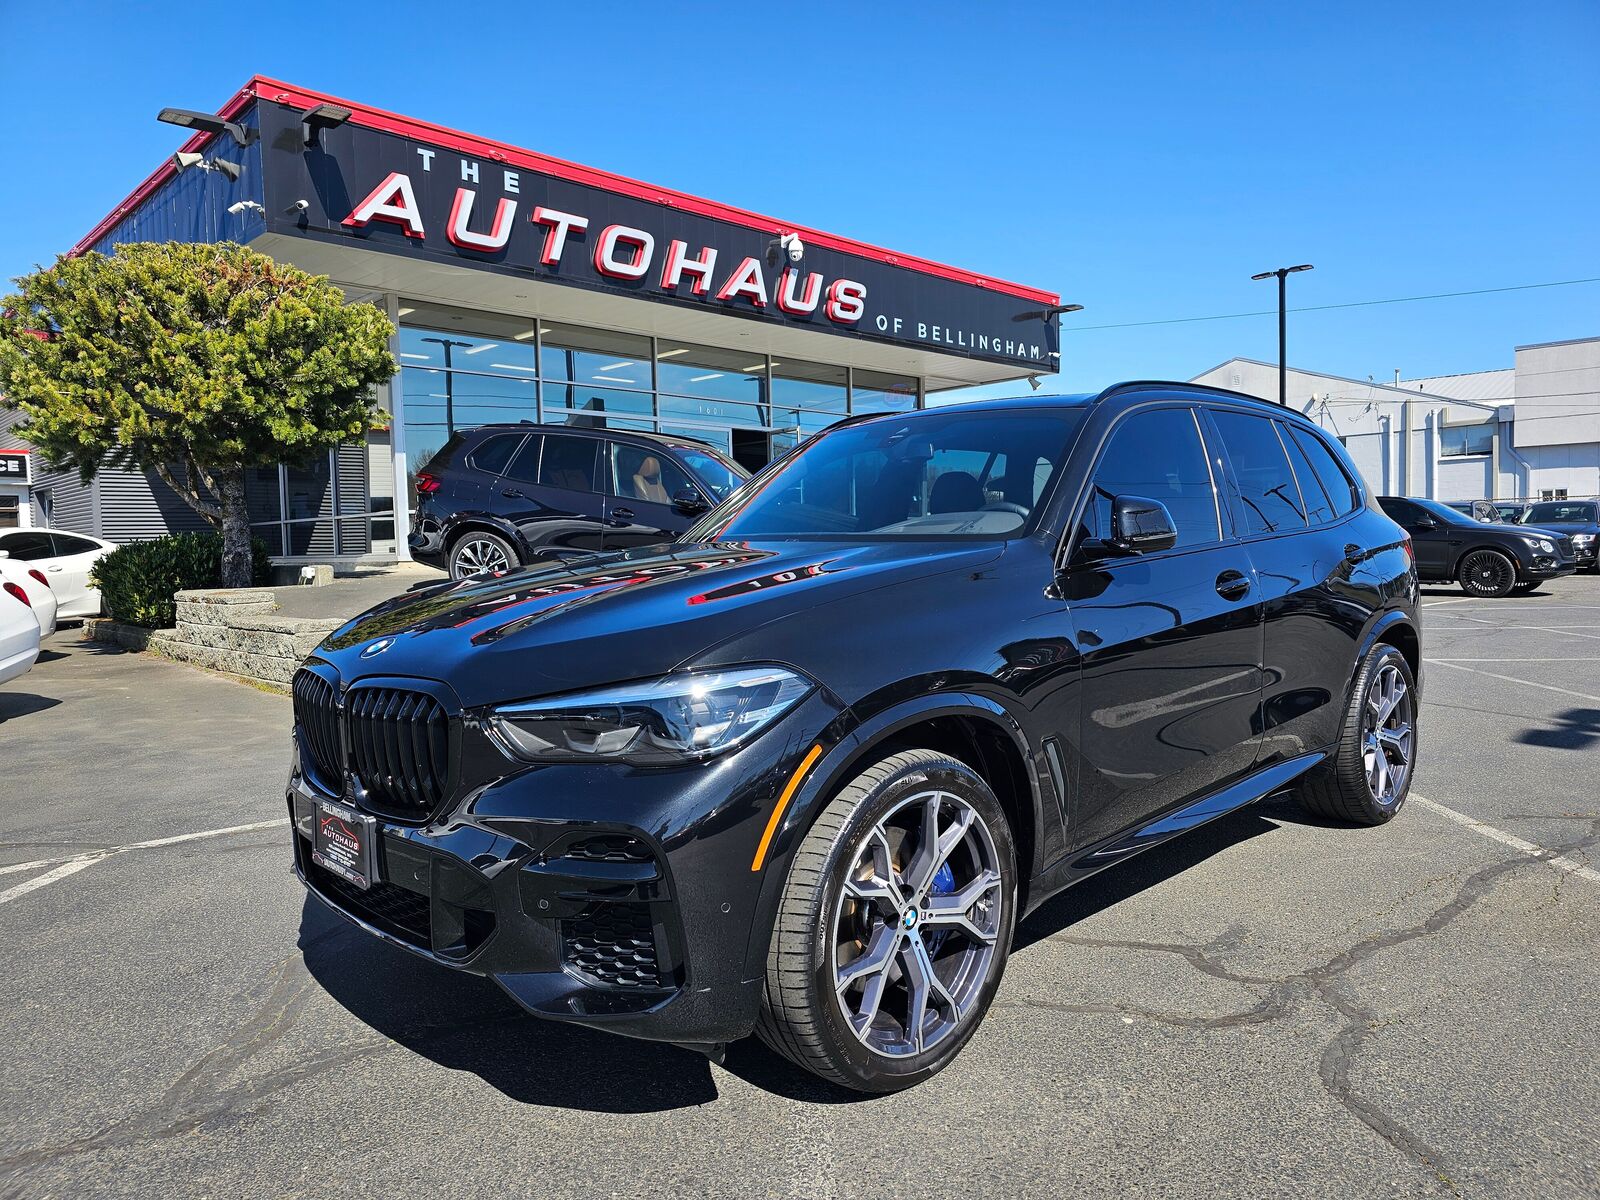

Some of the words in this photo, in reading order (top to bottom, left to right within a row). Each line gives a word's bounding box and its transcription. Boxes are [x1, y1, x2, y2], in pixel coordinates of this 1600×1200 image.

[417, 148, 520, 194] THE
[341, 171, 867, 324] AUTOHAUS
[875, 314, 903, 334] OF
[917, 322, 1040, 360] BELLINGHAM
[699, 405, 724, 416] 1601
[322, 828, 360, 850] AUTOHAUS
